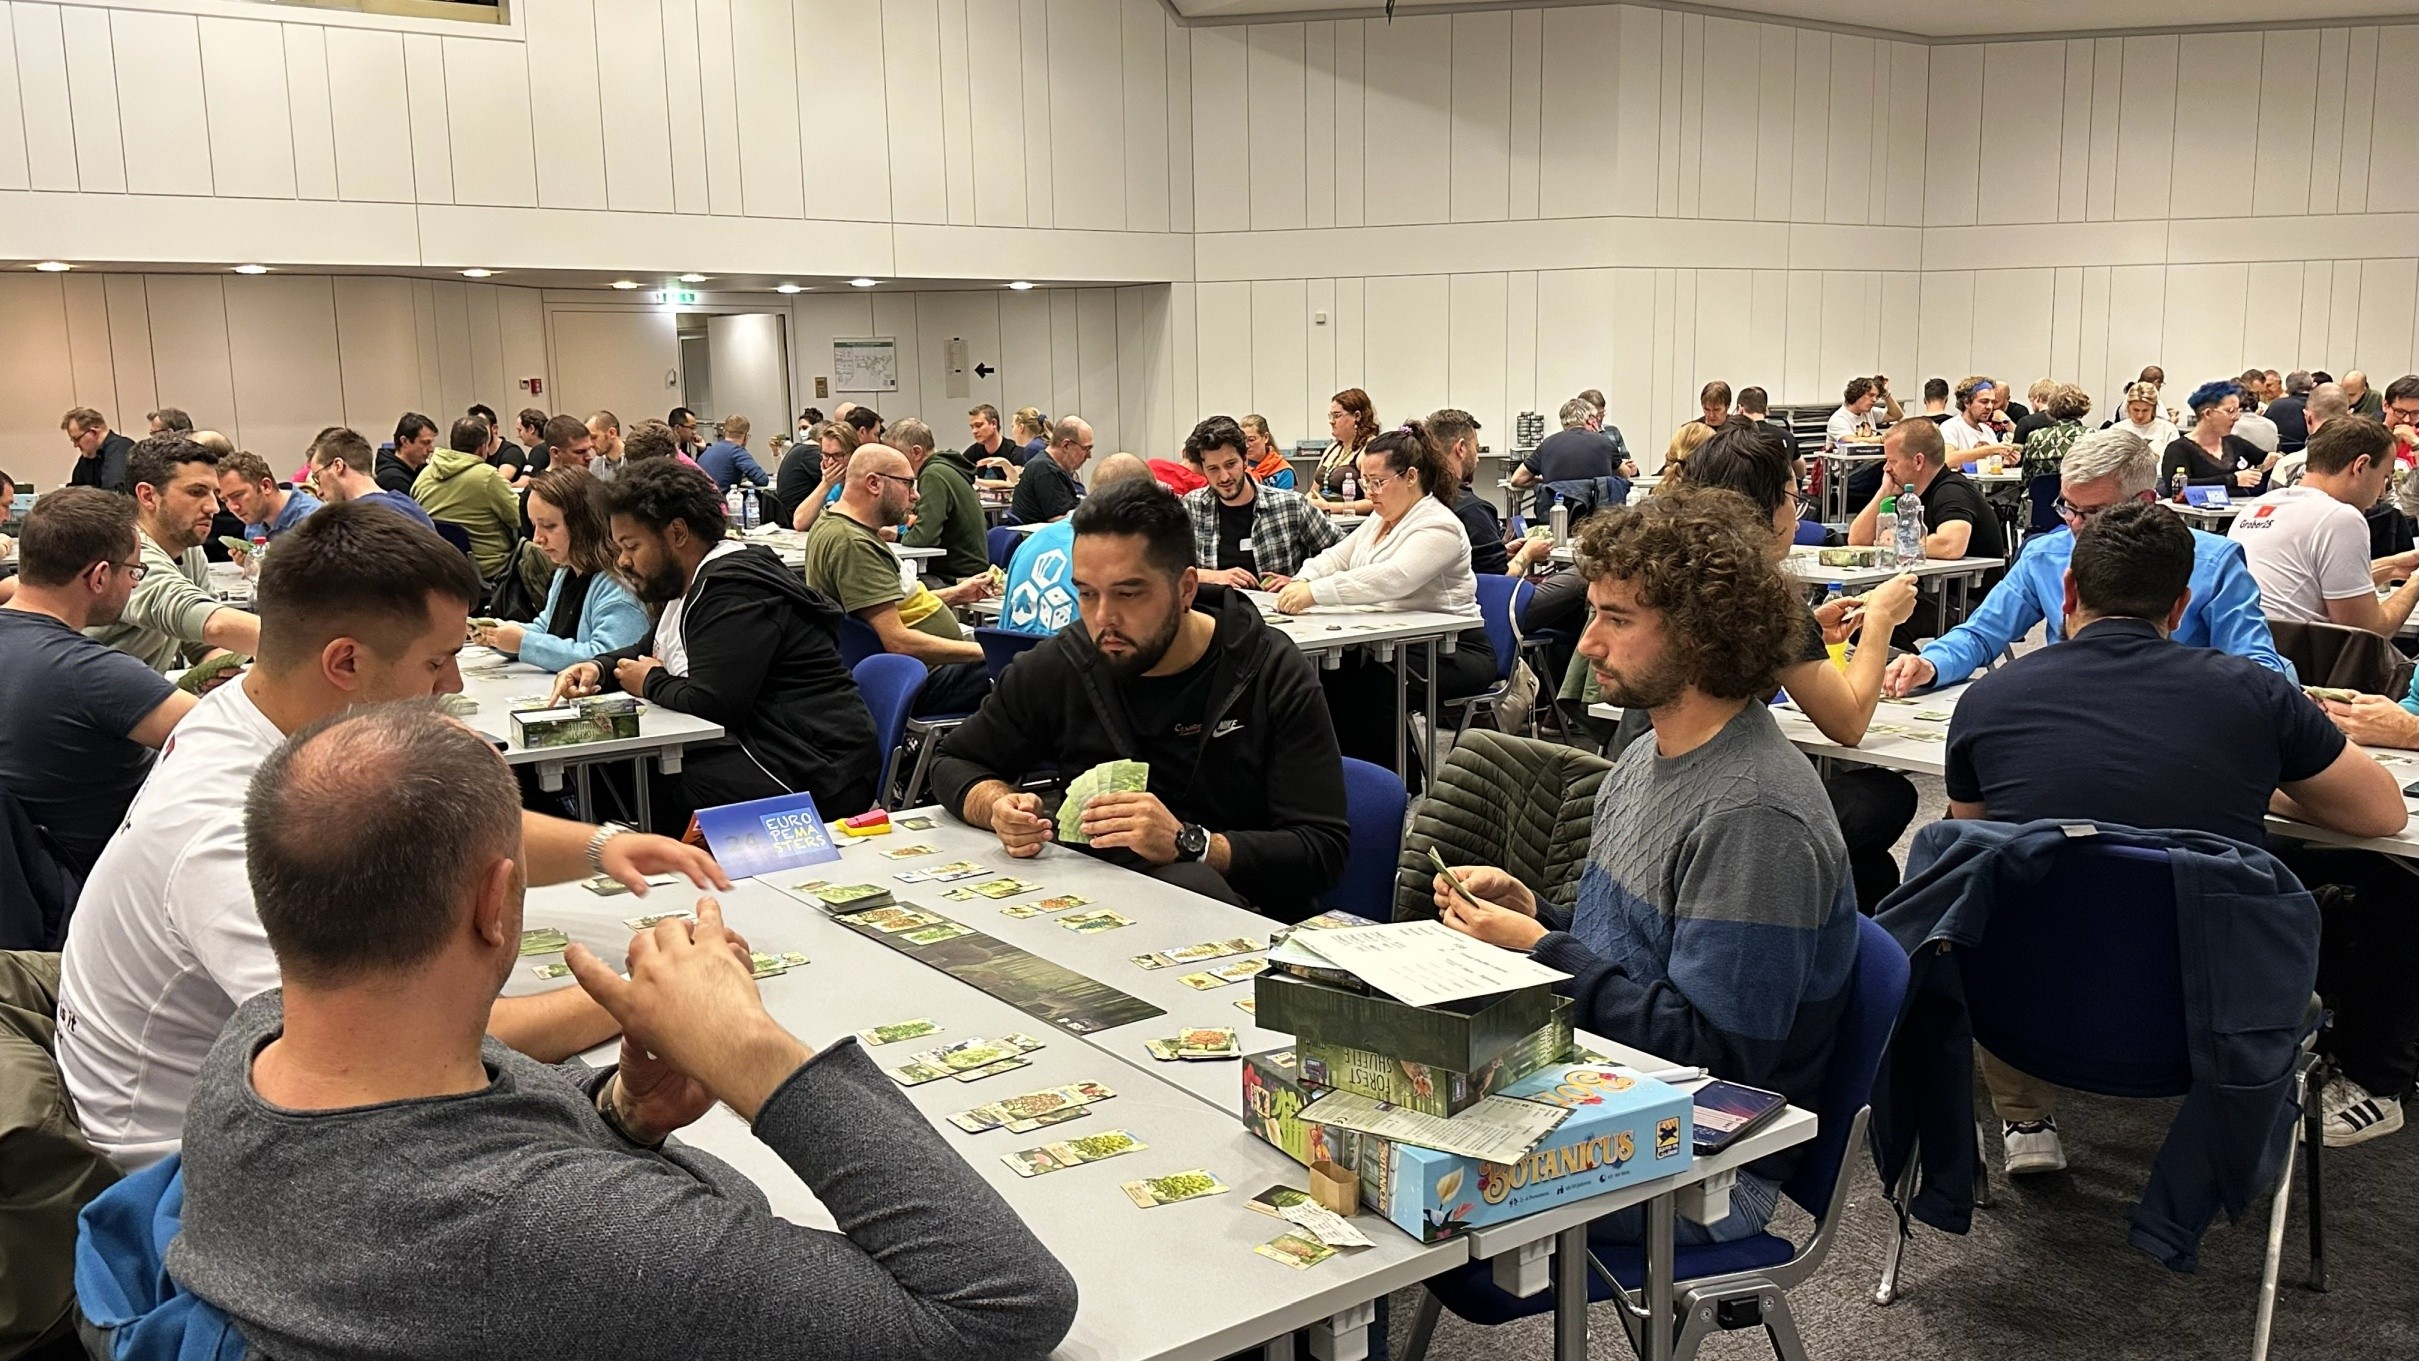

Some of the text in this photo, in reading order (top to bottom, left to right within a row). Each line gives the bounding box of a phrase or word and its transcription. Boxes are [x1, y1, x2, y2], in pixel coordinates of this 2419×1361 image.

[765, 812, 812, 830] EURO
[769, 826, 820, 842] PEMA
[772, 834, 826, 854] STERS
[1349, 1067, 1390, 1094] FOREST
[1479, 1130, 1635, 1204] BOTANICUS
